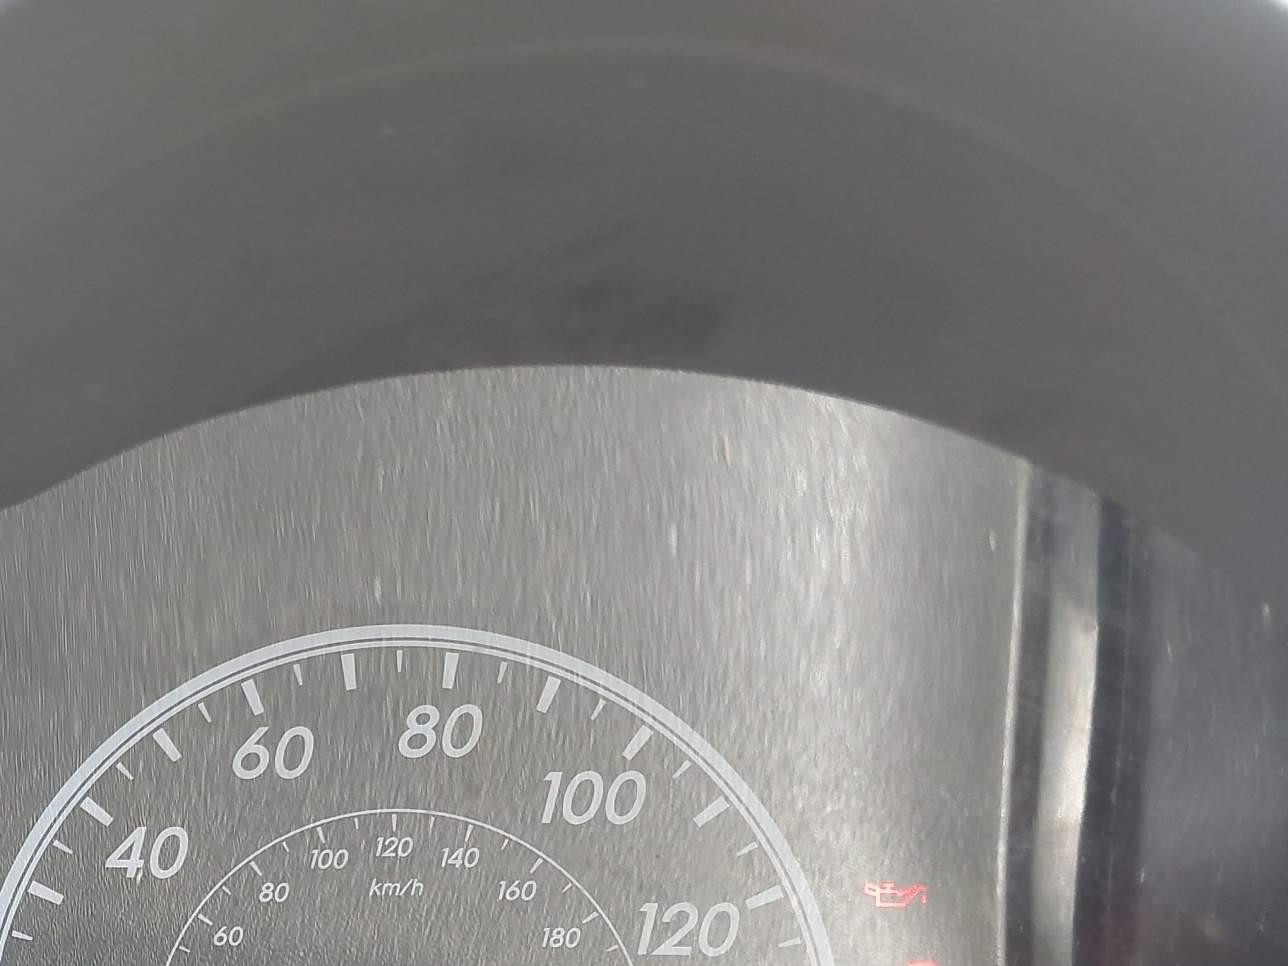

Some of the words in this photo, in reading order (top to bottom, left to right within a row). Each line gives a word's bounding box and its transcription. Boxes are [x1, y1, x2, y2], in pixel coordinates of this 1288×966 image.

[398, 704, 482, 758] 80
[232, 725, 314, 780] 60
[540, 770, 646, 825] 100
[105, 826, 188, 880] 40
[375, 836, 414, 858] 120
[440, 846, 480, 869] 140
[310, 848, 348, 871] 100
[258, 882, 290, 903] 80
[369, 878, 424, 899] km/h
[497, 880, 537, 902] 160
[213, 926, 244, 948] 60
[542, 927, 581, 950] 180
[636, 902, 740, 957] 120
